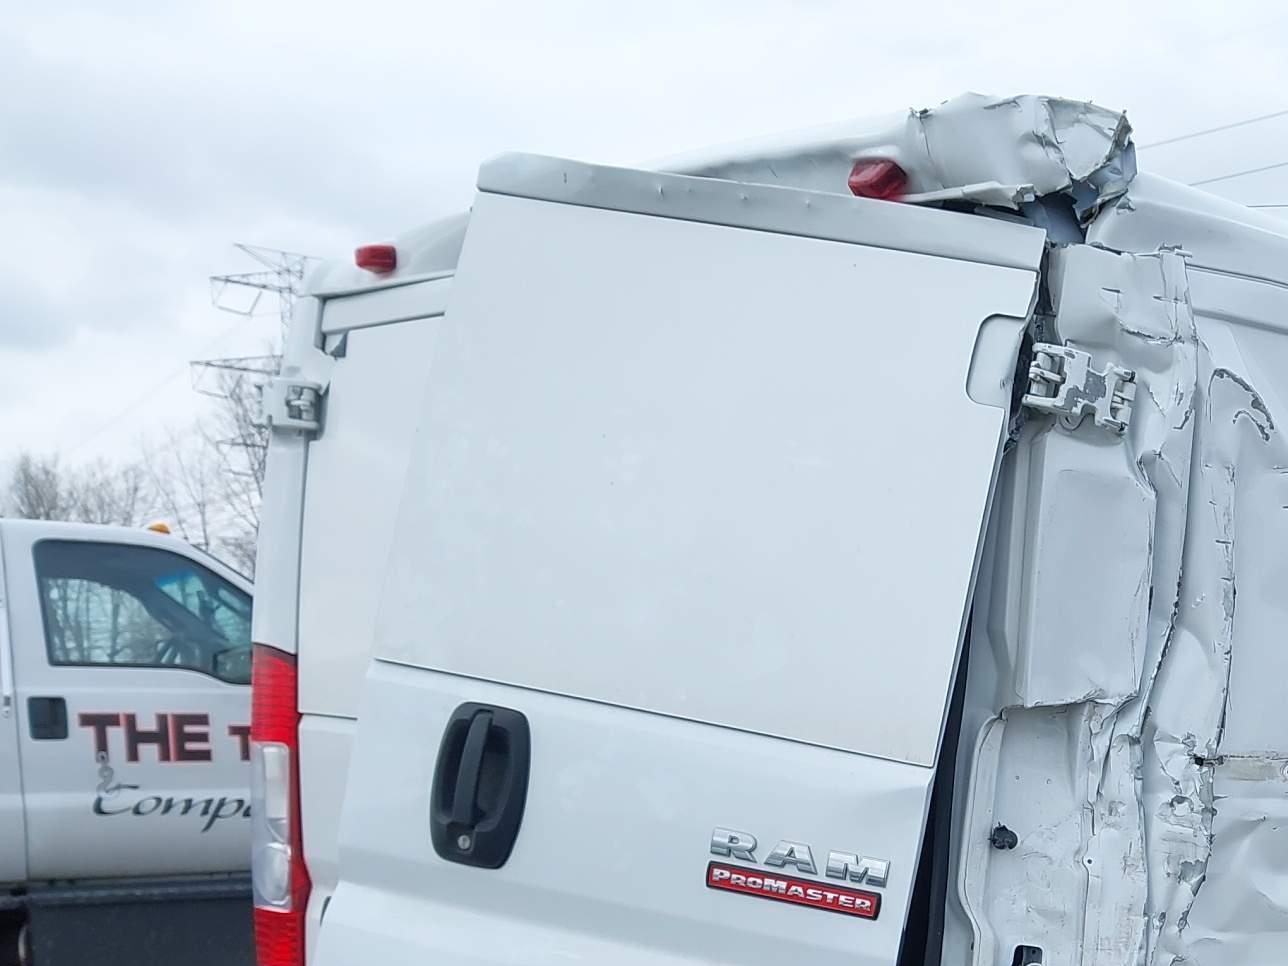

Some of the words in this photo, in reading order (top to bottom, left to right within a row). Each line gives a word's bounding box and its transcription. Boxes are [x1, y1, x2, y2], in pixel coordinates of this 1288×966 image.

[77, 712, 213, 763] THE
[93, 784, 251, 834] Comp
[709, 826, 891, 888] RAM
